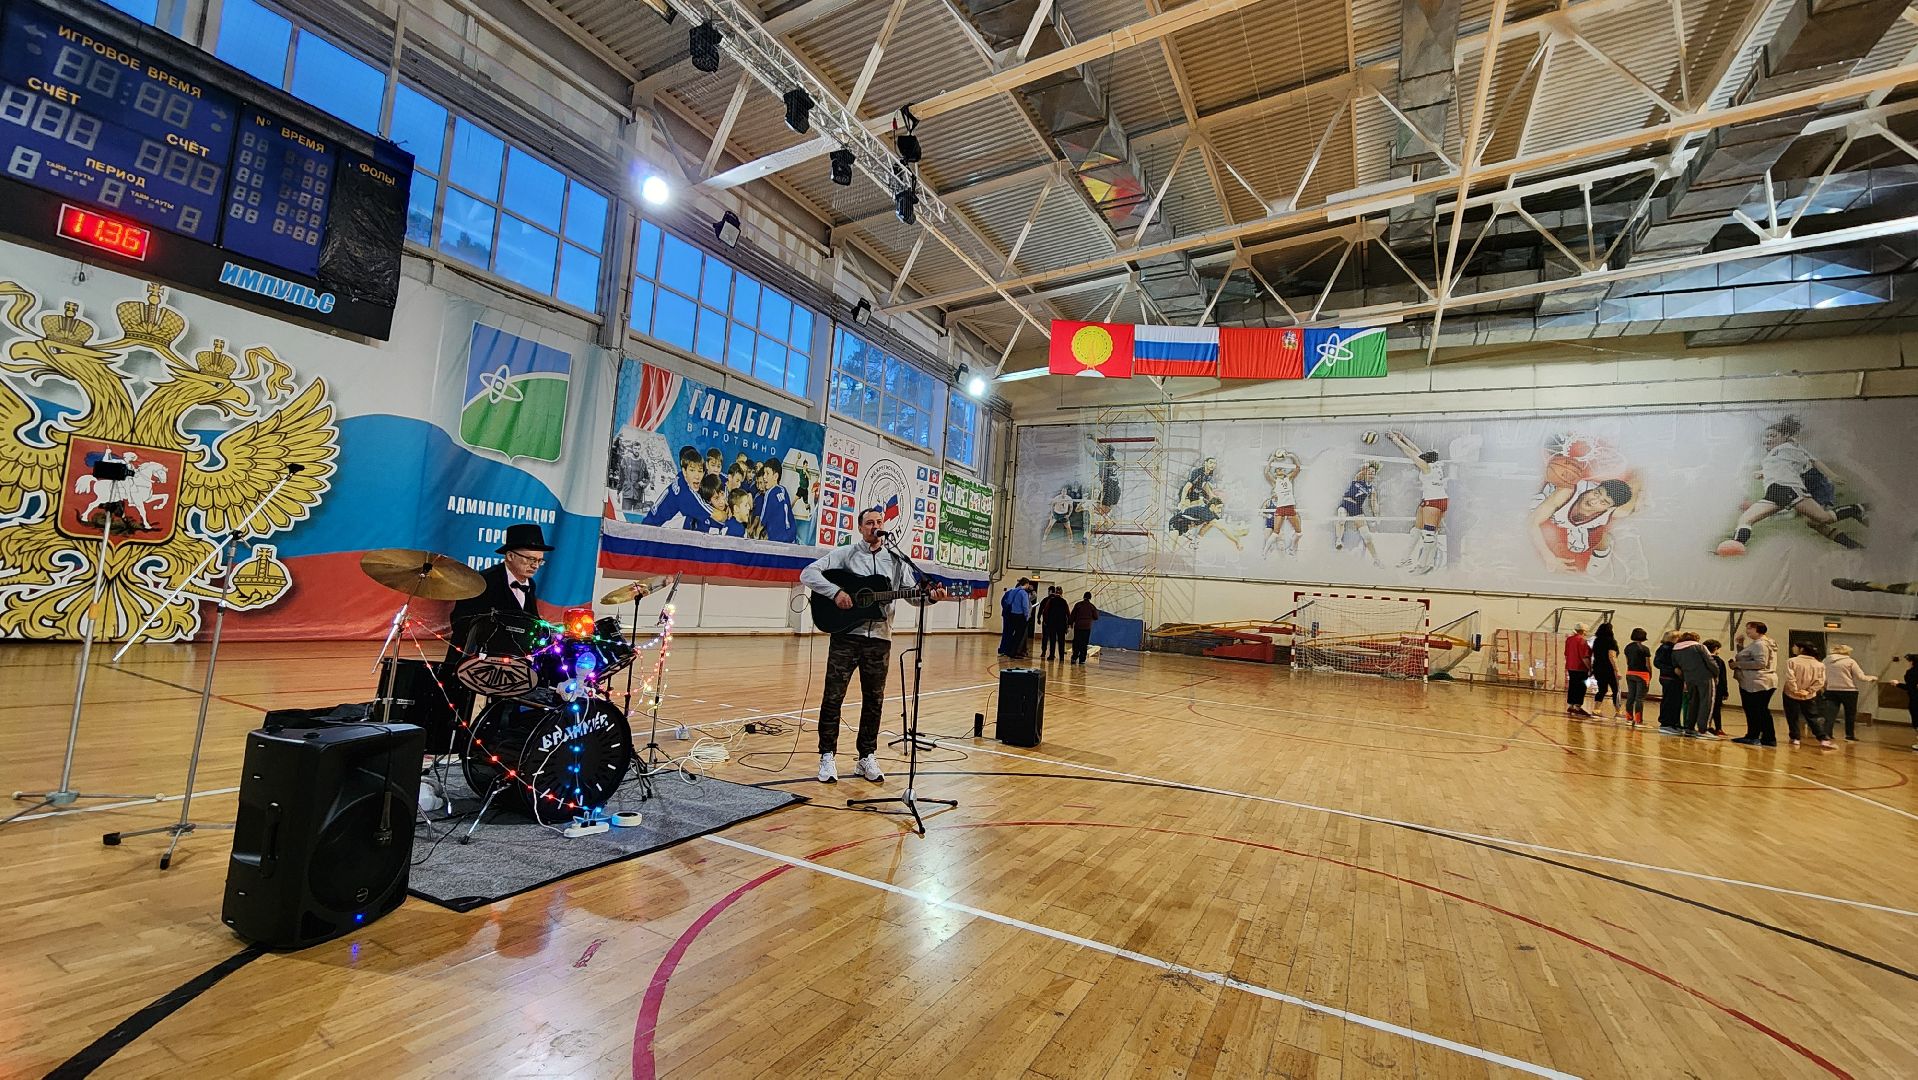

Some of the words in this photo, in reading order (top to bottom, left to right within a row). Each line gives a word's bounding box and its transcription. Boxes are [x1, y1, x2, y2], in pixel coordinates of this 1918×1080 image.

[58, 24, 141, 71] ИГРОВОЕ
[147, 65, 202, 99] ВРЕМЯ
[27, 76, 81, 105] СЧЁТ
[166, 133, 210, 158] СЧЁТ
[281, 126, 325, 154] ВРЕМЯ
[85, 157, 146, 189] ПЕРИОД
[359, 162, 396, 186] ФОЛЫ
[218, 261, 336, 315] ИМПУЛЬС
[688, 388, 782, 441] ГАНДБОЛ
[686, 422, 694, 433] В
[701, 427, 777, 456] ПРОТВИНО
[447, 495, 557, 525] АДМИНИСТРАЦИЯ
[478, 527, 508, 545] ГОРО
